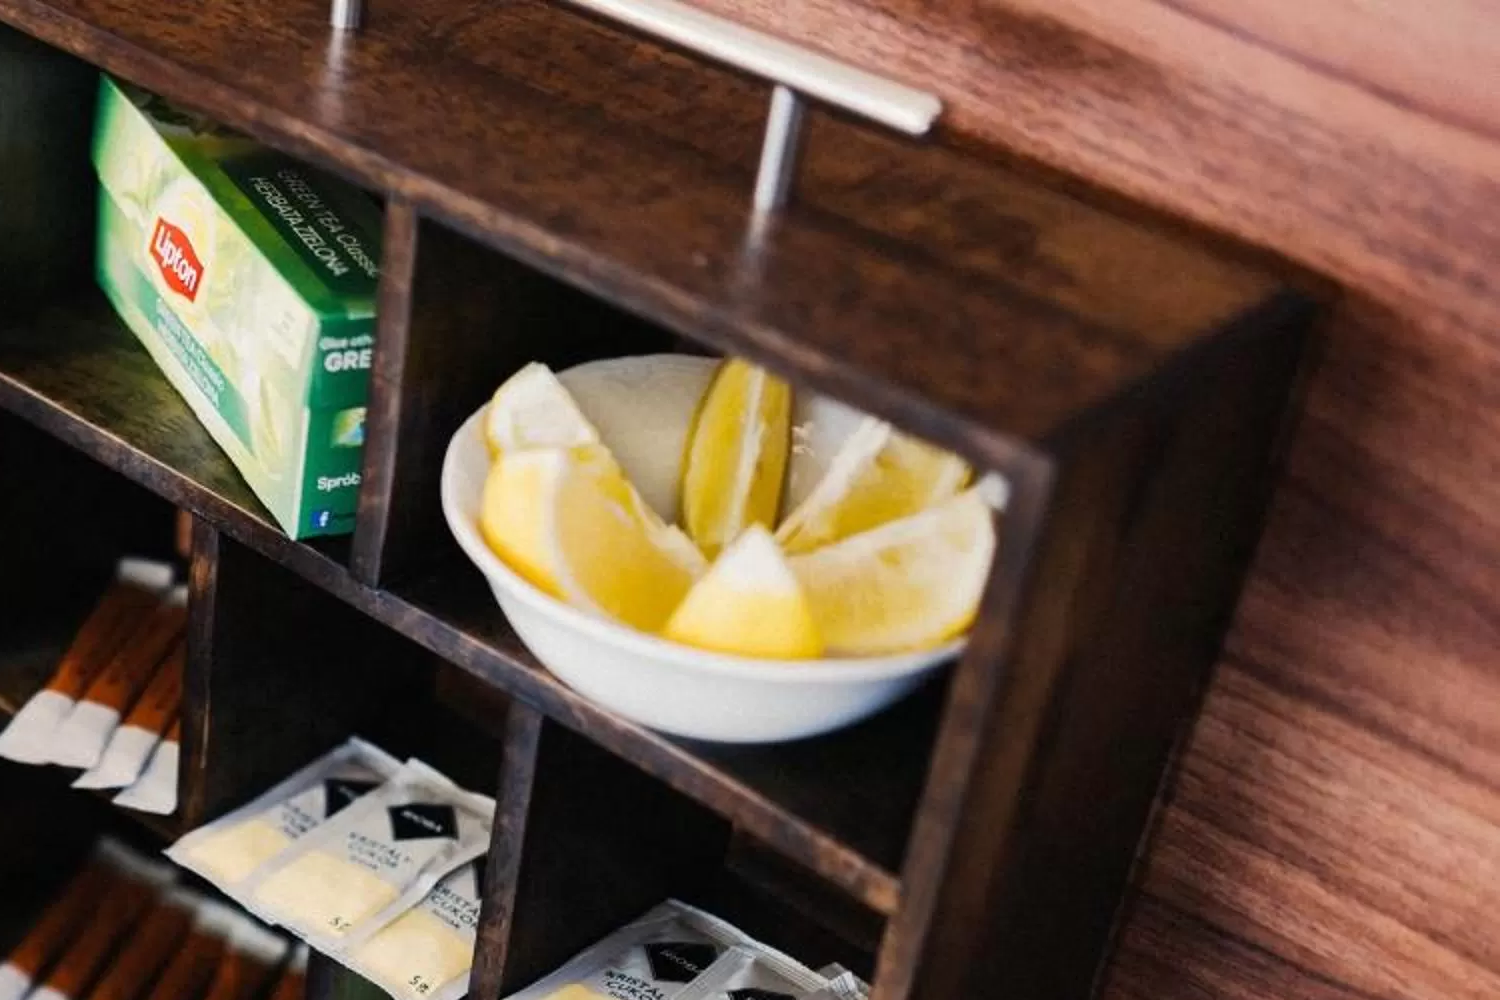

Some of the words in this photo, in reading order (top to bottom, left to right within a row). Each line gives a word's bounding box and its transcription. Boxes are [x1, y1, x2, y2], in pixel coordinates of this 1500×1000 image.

[156, 225, 197, 292] Lipton
[250, 177, 304, 225] HERBATA
[291, 225, 350, 277] ZIELONA
